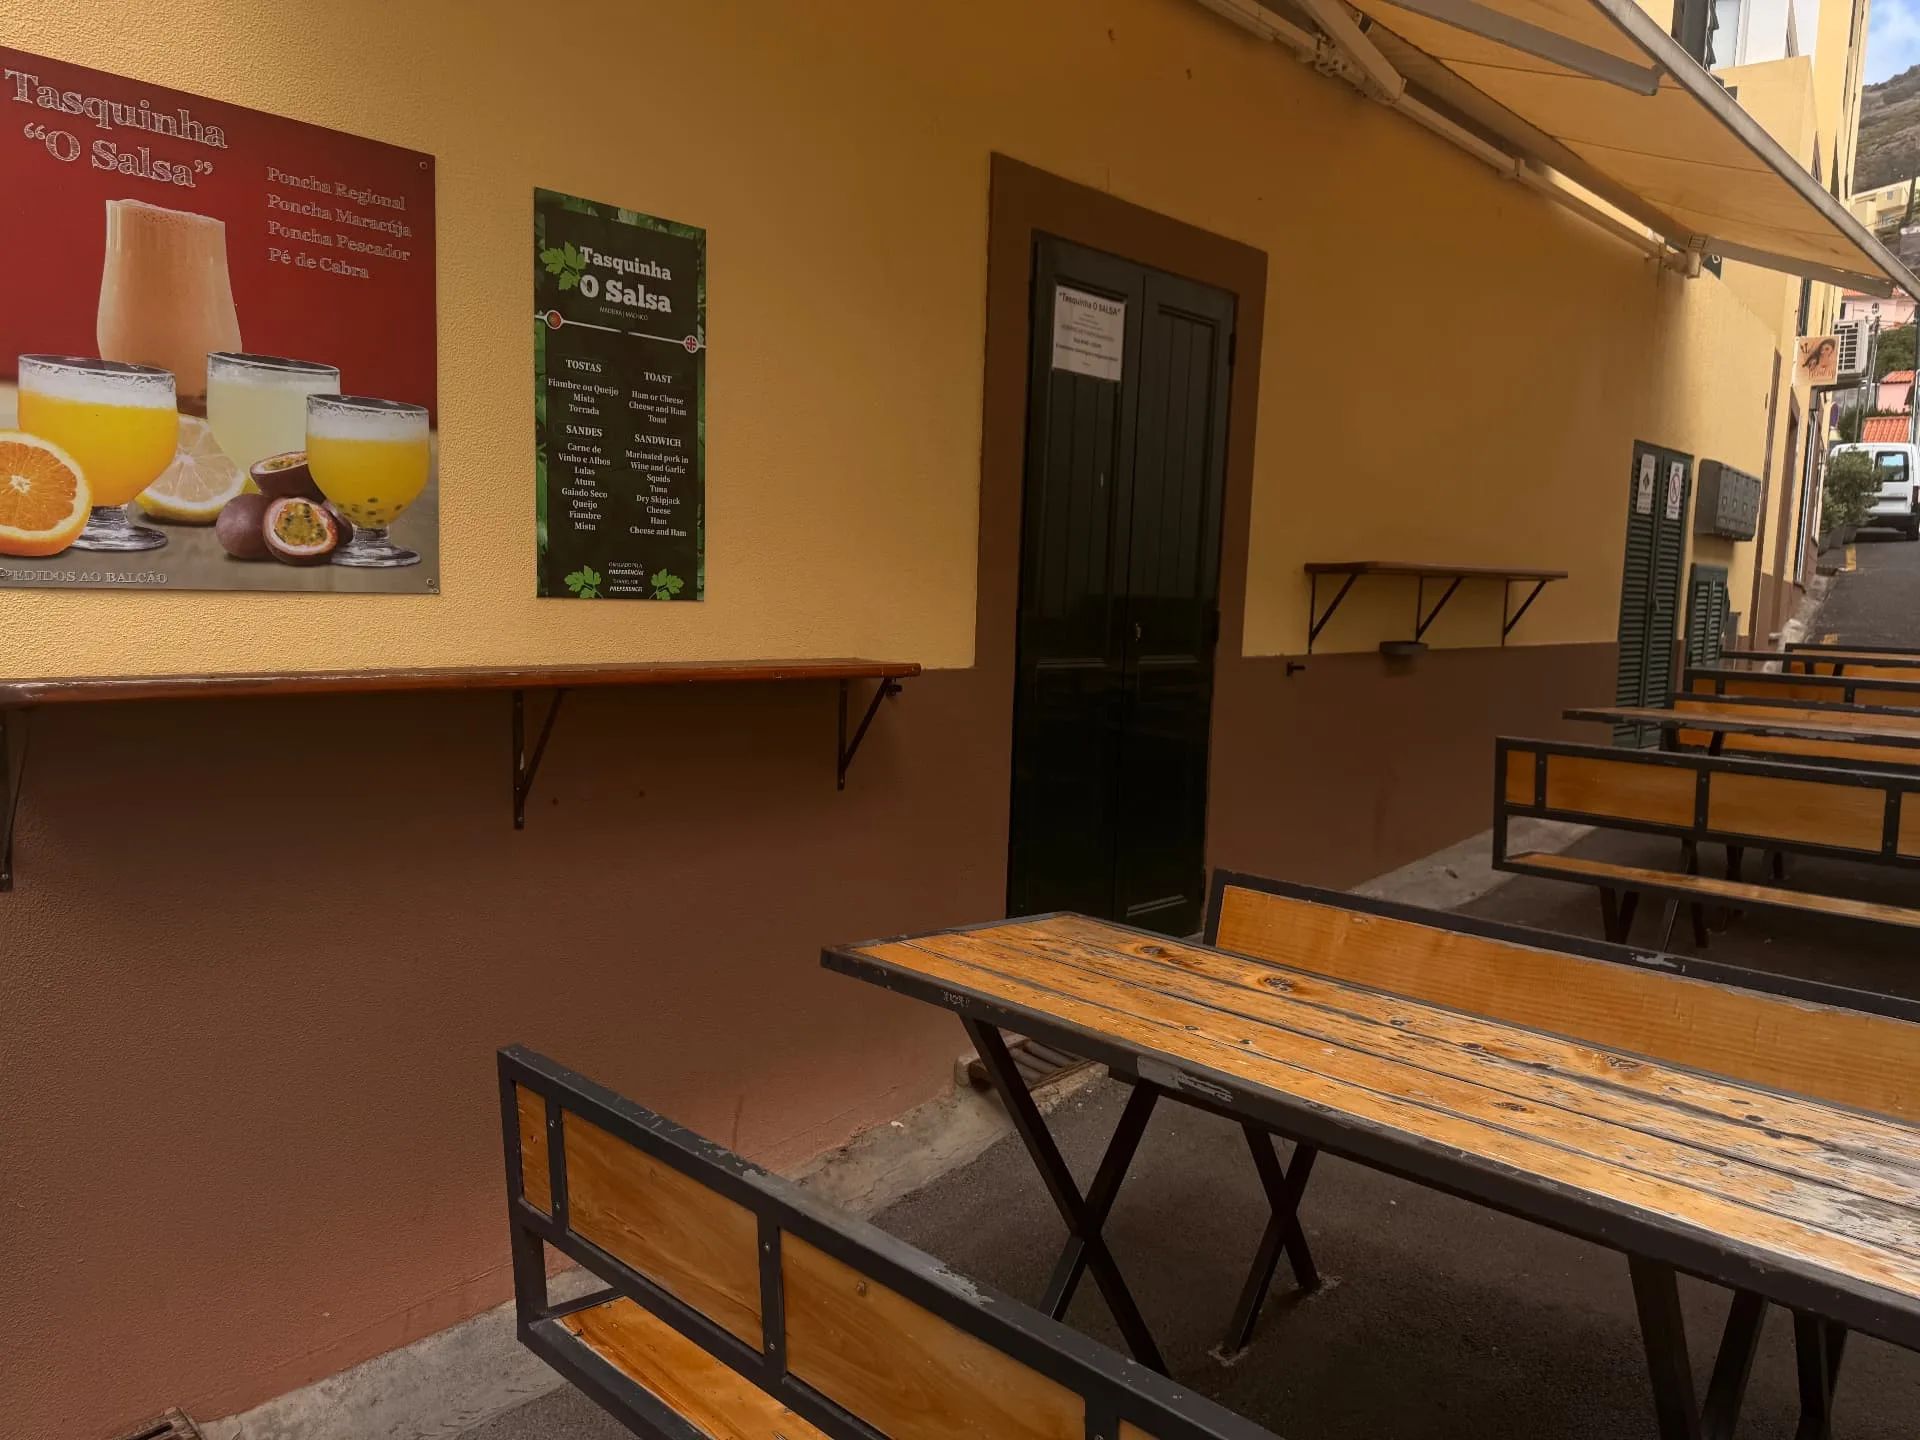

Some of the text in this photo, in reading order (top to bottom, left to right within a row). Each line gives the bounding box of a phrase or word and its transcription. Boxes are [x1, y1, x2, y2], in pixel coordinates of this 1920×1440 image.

[5, 68, 228, 148] Tasquinha
[267, 166, 406, 211] Poncha Regional
[267, 193, 332, 221] Poncha
[267, 220, 411, 262] Poncha Pescador
[269, 247, 369, 279] Pé de Cabra
[580, 246, 671, 281] Tasquinha
[580, 274, 672, 313] O Salsa
[565, 359, 602, 373] TOSTAS
[644, 371, 672, 384] TOAST
[548, 378, 619, 397] Fiambre ou Queijo
[573, 393, 595, 404] Mista
[632, 390, 684, 405] Ham or Cheese
[568, 403, 600, 416] Torrada
[628, 400, 687, 417] Cheese and Ham
[648, 414, 667, 425] Toast
[566, 424, 603, 438] SANDES
[634, 433, 682, 448] SANDWICH
[567, 442, 602, 454] Carne de
[558, 453, 582, 464] Vinho
[589, 457, 611, 466] Alhos
[625, 450, 689, 464] Marinated pork in
[574, 466, 596, 476] Lulas
[630, 461, 686, 474] Wine and Garlic
[574, 477, 596, 487] Atum
[646, 474, 671, 484] Squids
[561, 487, 608, 499] Gaiado Seco
[650, 484, 668, 494] Tuna
[572, 499, 598, 511] Queijo
[636, 494, 681, 506] Dry Skipjack
[569, 511, 602, 521] Fiambre
[646, 506, 672, 515] Cheese
[574, 522, 596, 532] Mista
[650, 516, 667, 526] Ham
[629, 526, 687, 538] Cheese and Ham
[79, 571, 101, 582] AO
[104, 568, 168, 584] BALCÃO
